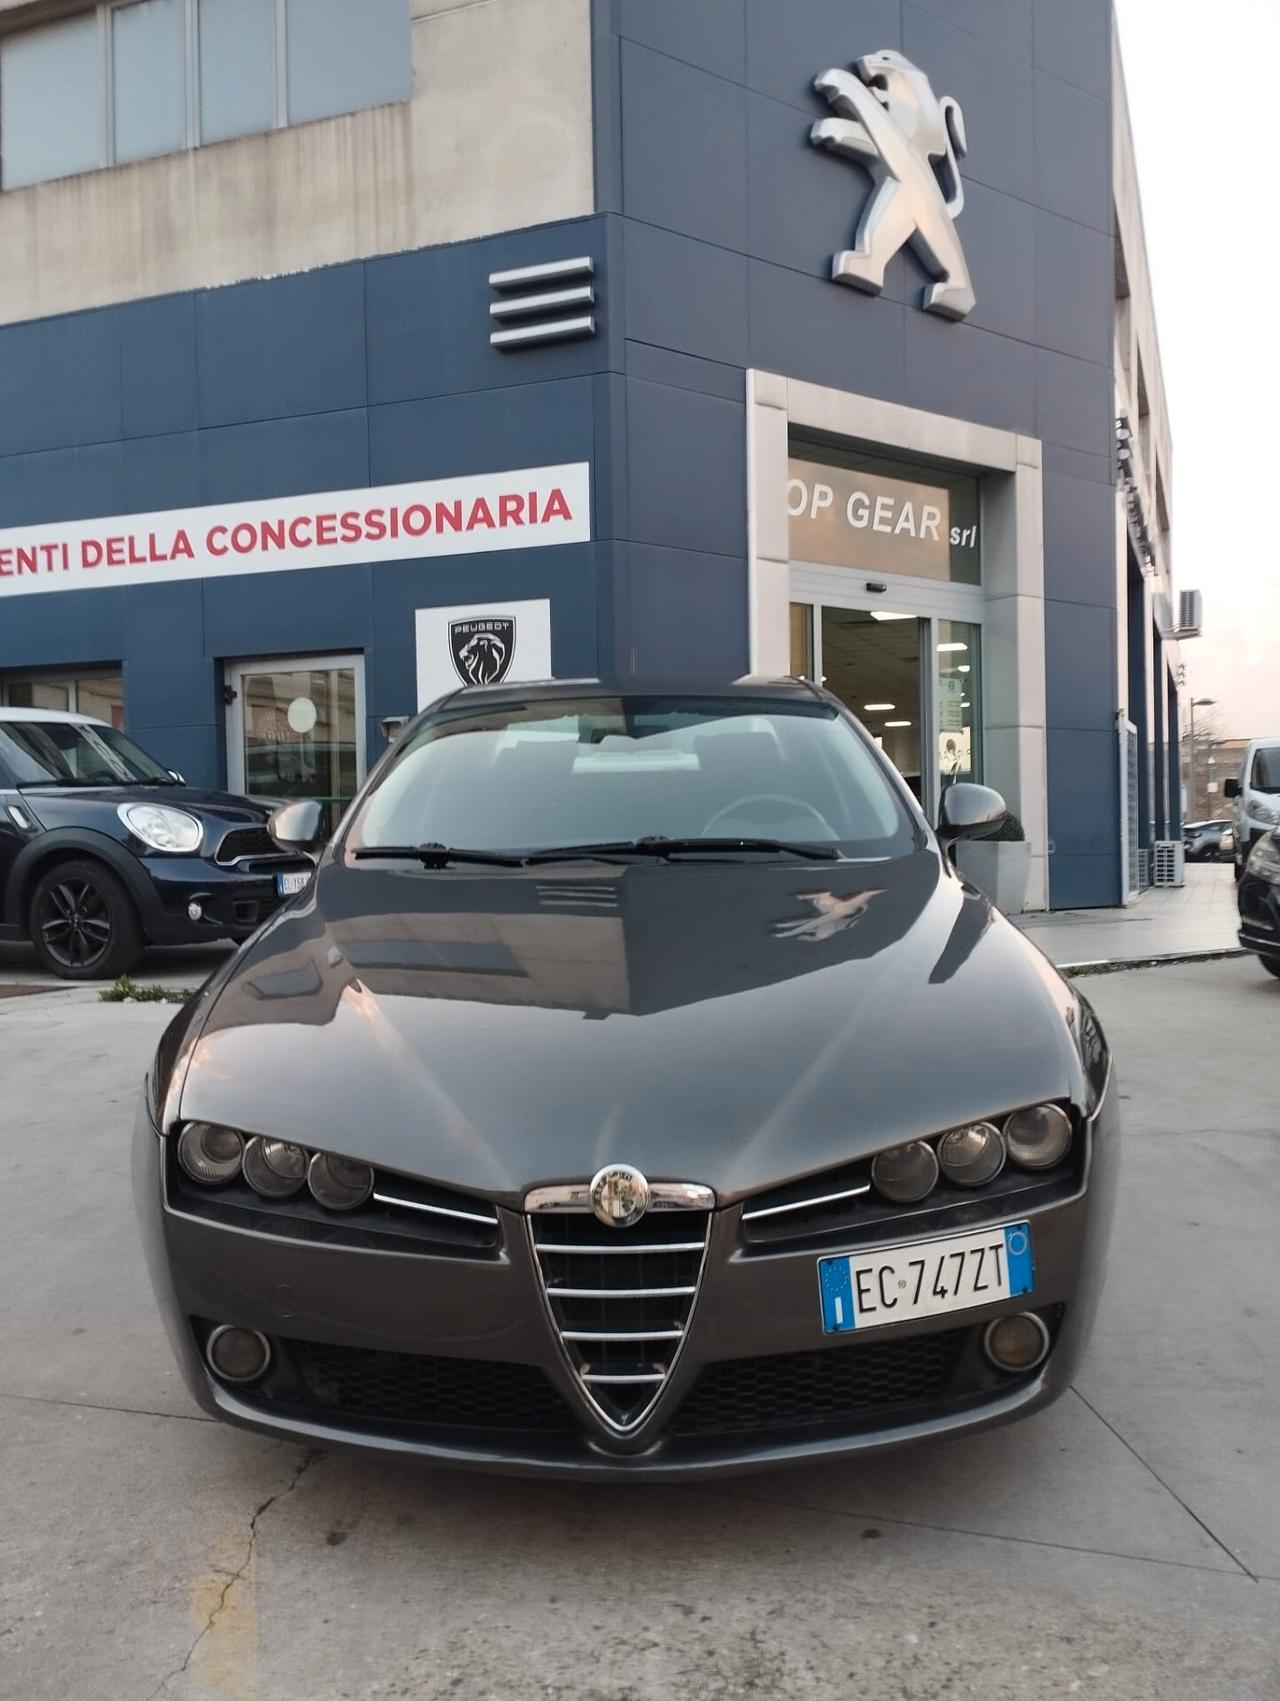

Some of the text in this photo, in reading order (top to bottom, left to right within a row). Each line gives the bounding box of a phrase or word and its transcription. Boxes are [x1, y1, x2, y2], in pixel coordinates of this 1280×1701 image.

[0, 488, 573, 576] ENTI DELLA CONCESSIONARIA
[846, 491, 942, 541] GEAR
[949, 525, 977, 549] srl
[454, 622, 510, 634] PEUGEOT
